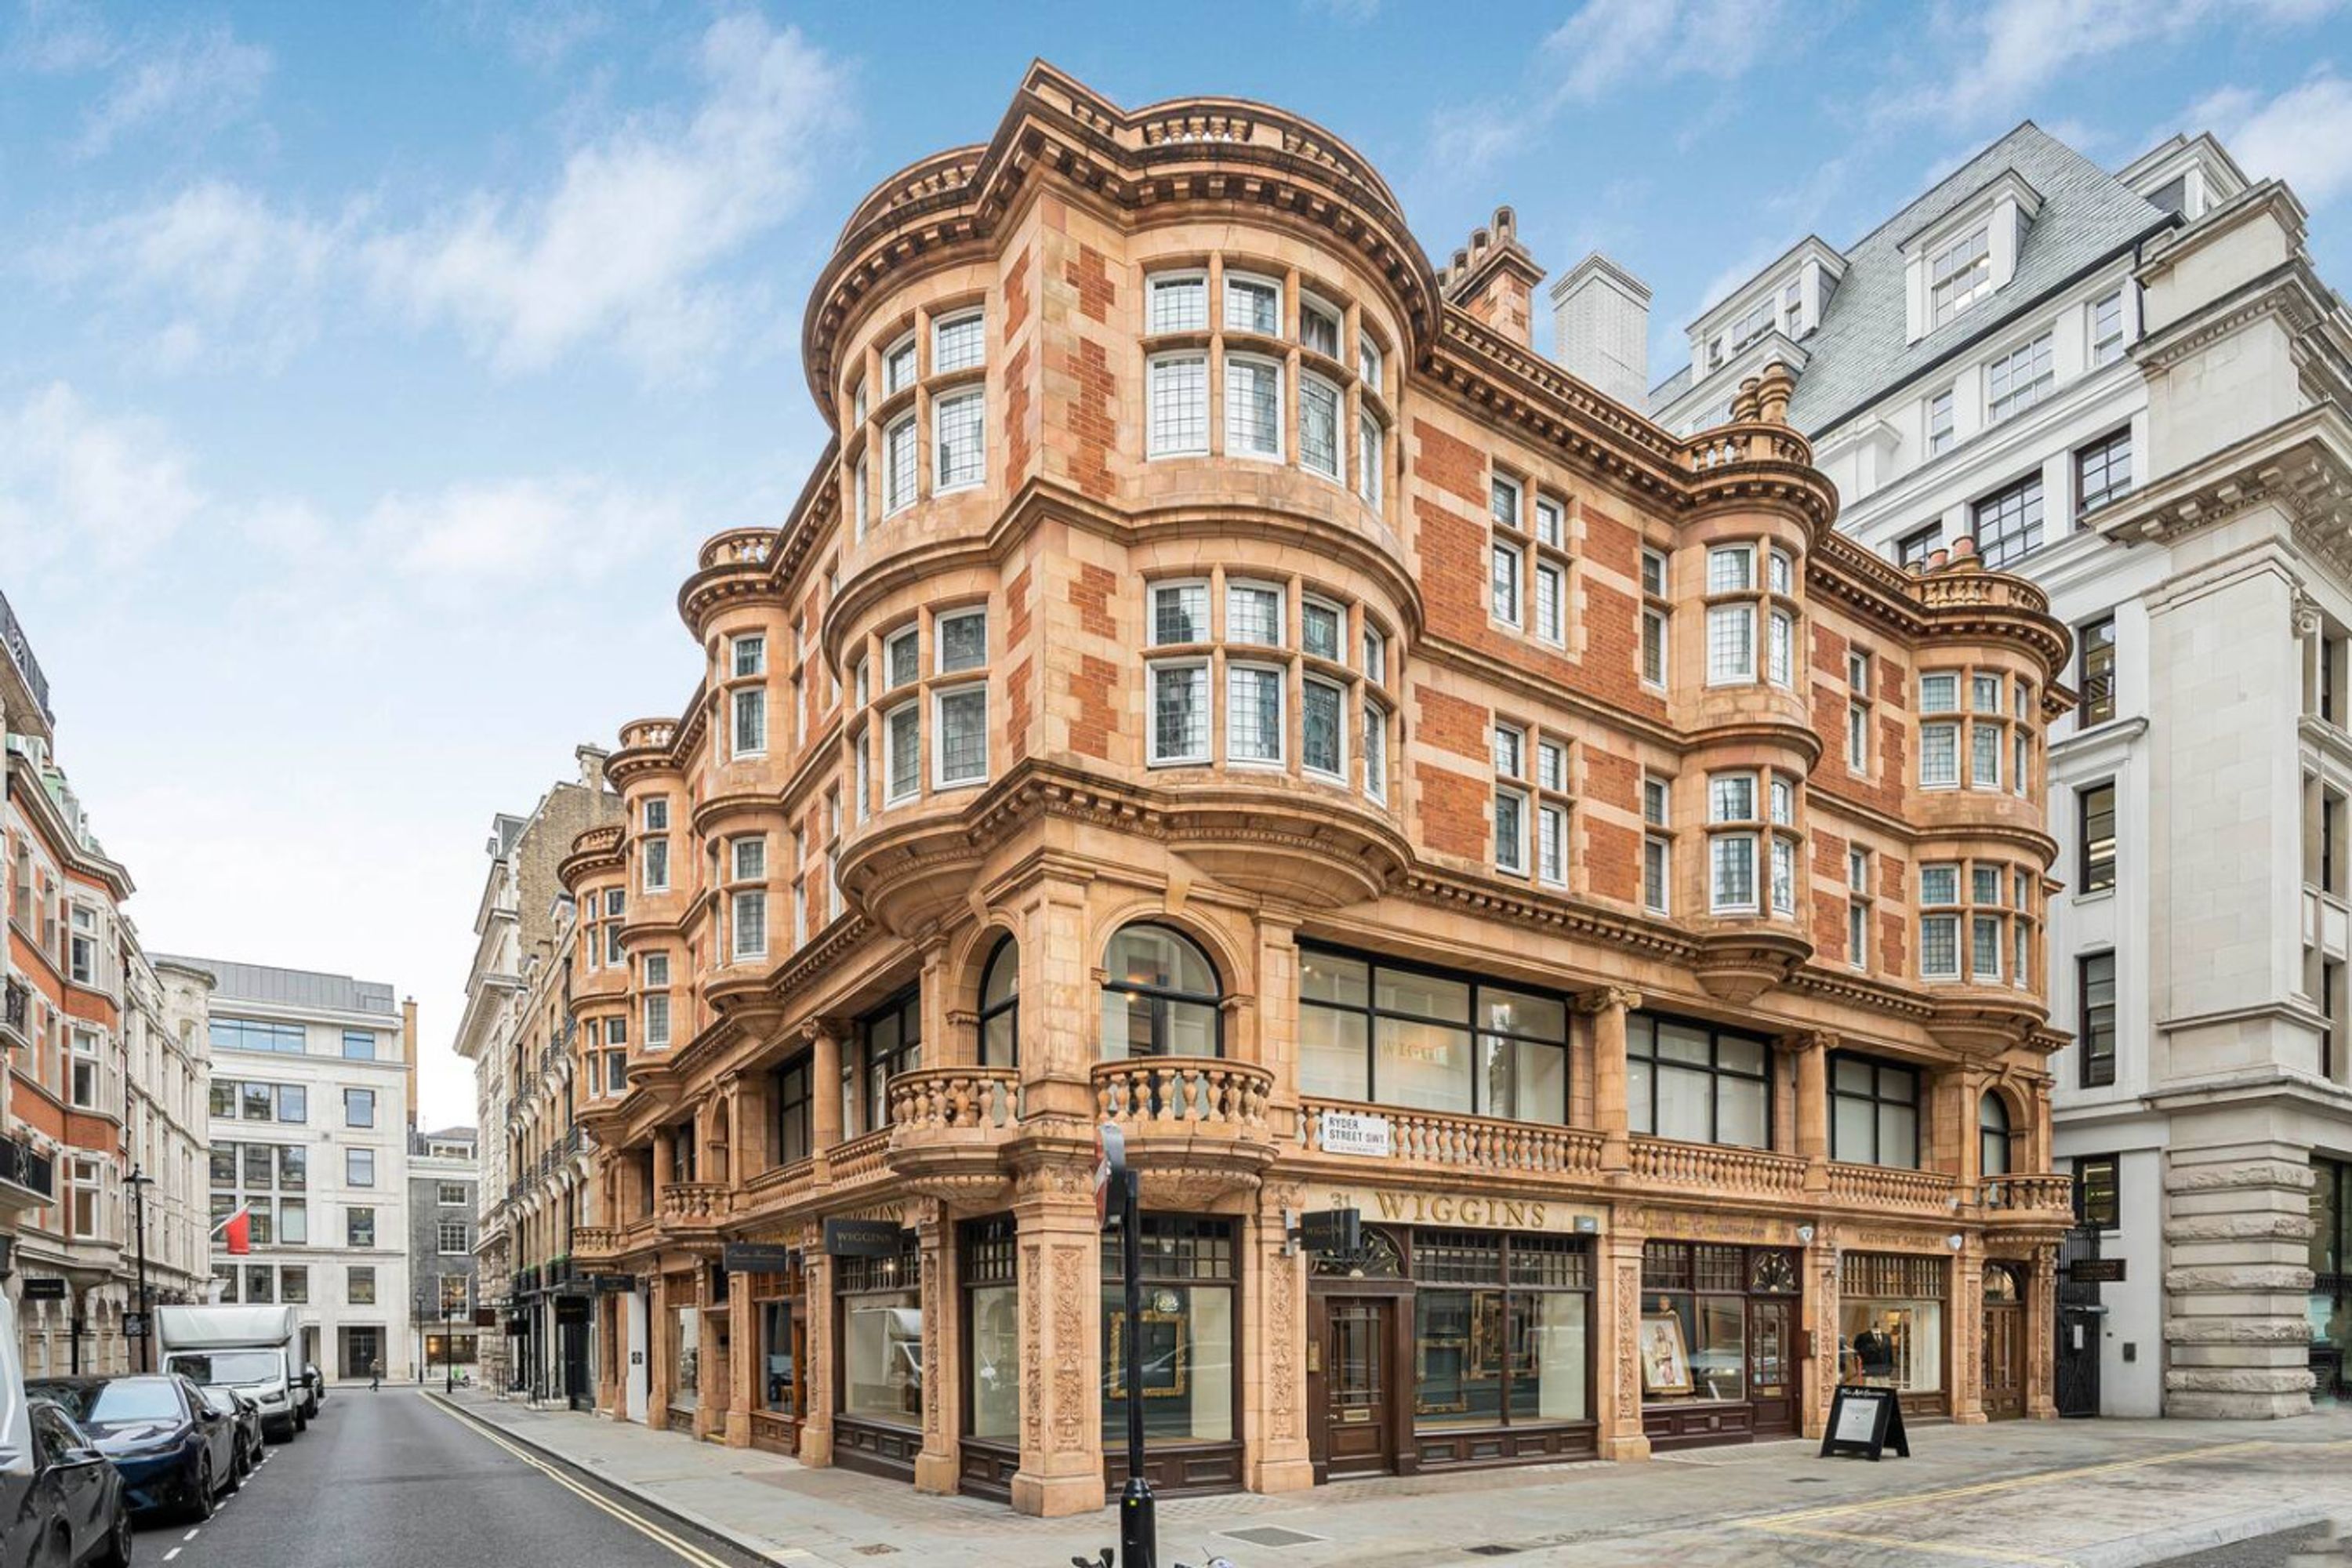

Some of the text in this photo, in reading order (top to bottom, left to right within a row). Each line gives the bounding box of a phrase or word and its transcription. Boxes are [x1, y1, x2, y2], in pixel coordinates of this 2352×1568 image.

[1329, 1116, 1358, 1129] RYDER
[1329, 1129, 1362, 1142] STREET
[1331, 1192, 1350, 1209] 31
[1375, 1191, 1545, 1229] WIGGINS
[837, 1232, 891, 1243] WIGGINS
